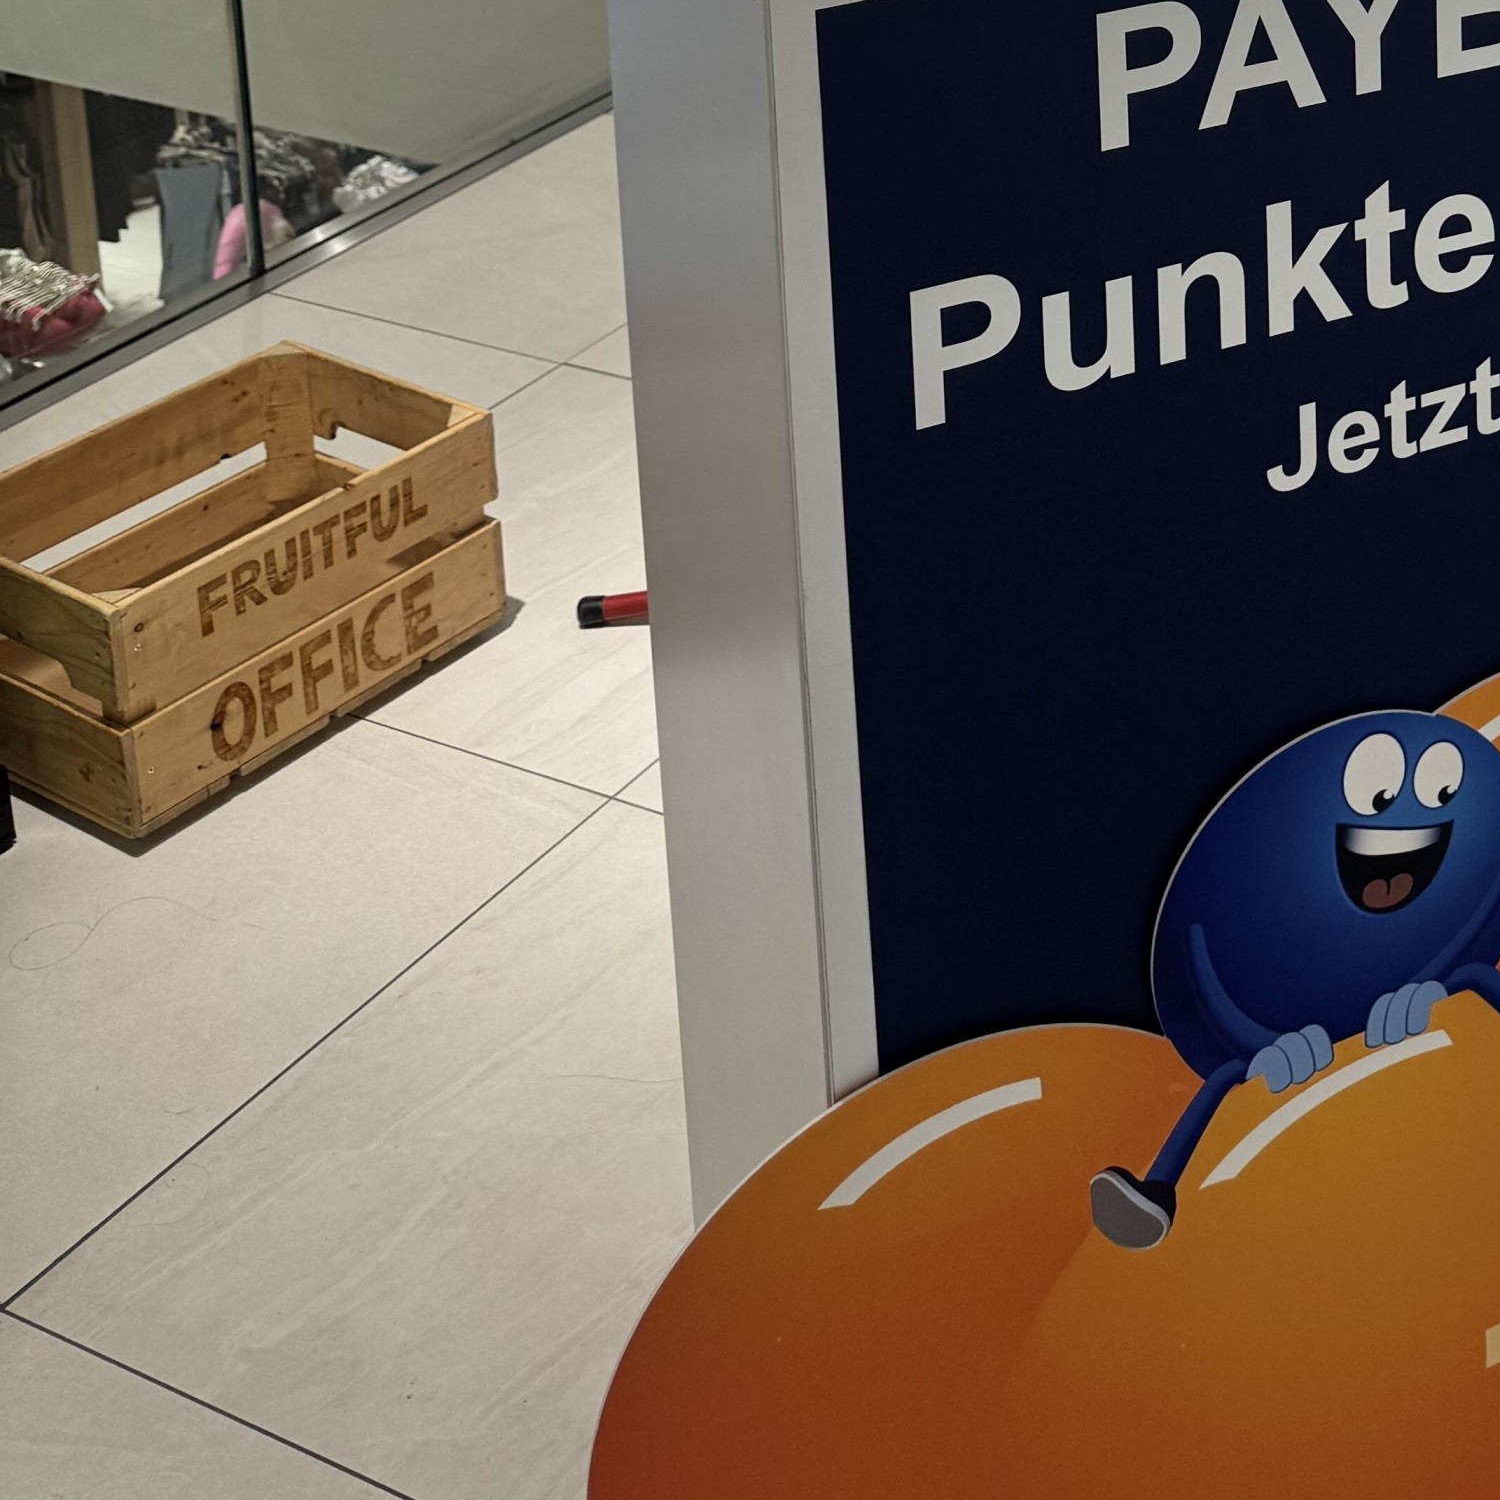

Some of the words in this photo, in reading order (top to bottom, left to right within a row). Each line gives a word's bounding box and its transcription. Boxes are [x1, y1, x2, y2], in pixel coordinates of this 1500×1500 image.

[909, 180, 1496, 430] Punkte
[197, 477, 429, 637] FRUITFUL
[211, 570, 439, 763] OFFICE
